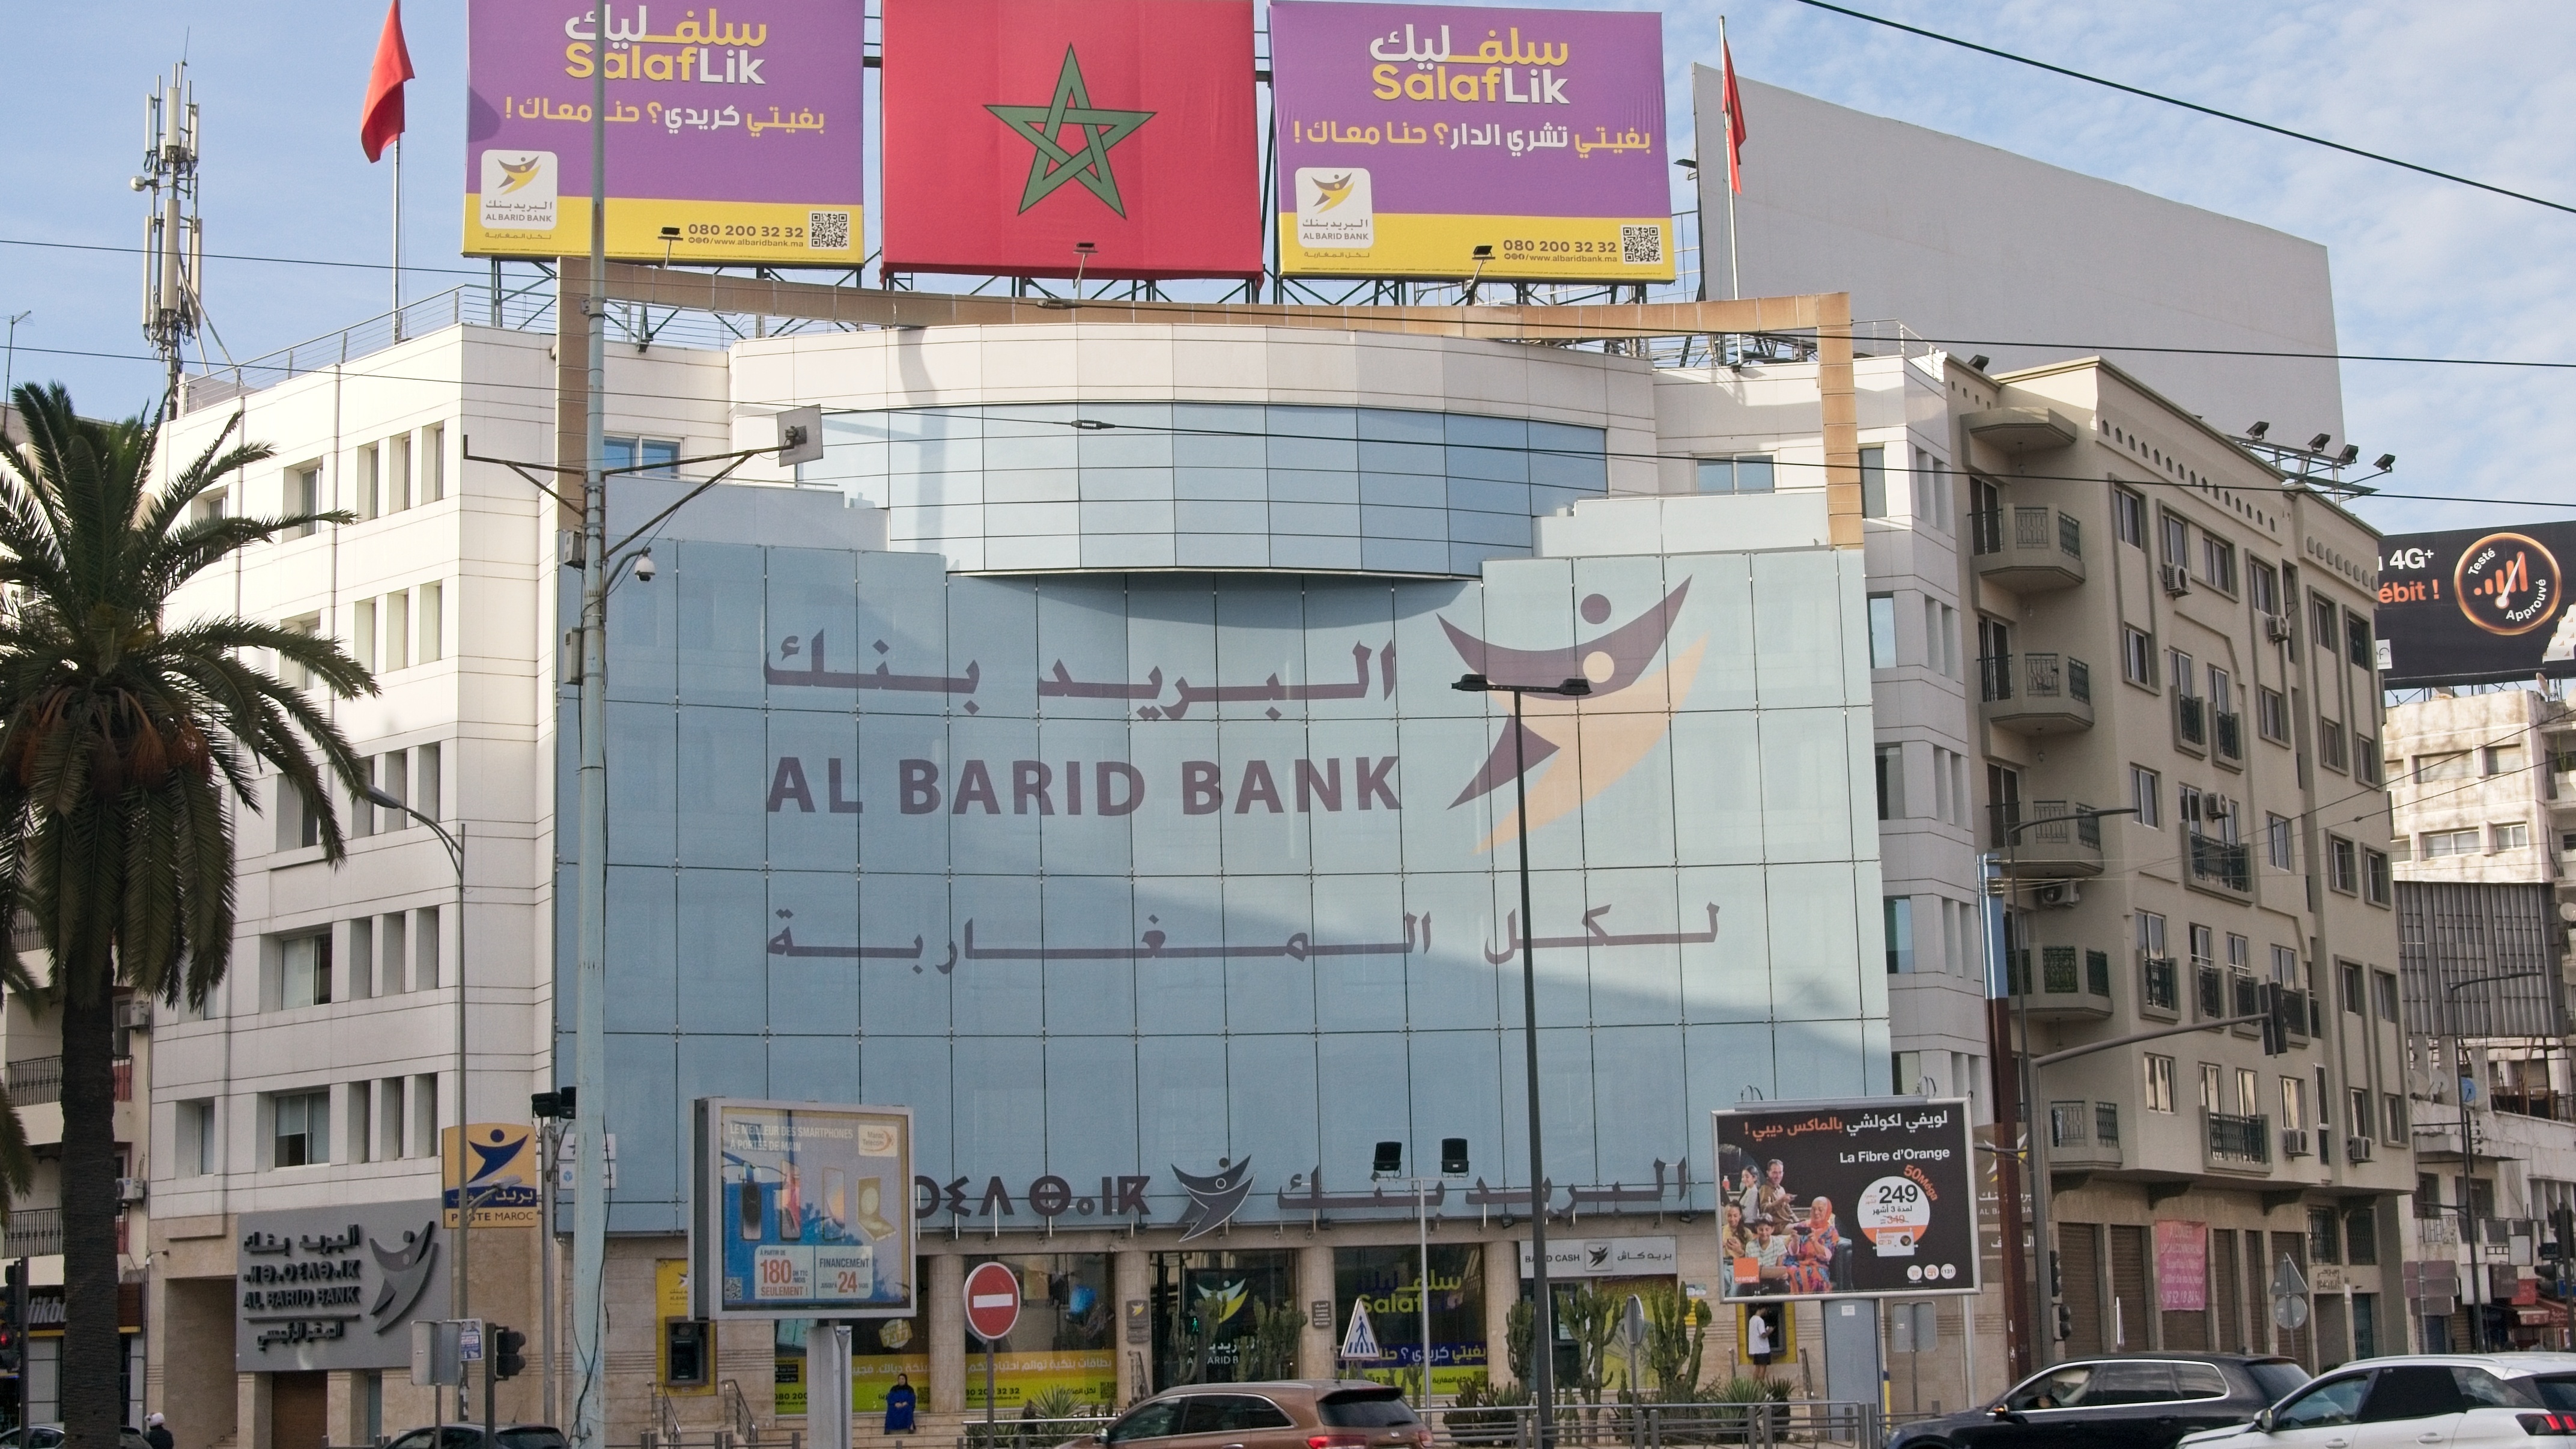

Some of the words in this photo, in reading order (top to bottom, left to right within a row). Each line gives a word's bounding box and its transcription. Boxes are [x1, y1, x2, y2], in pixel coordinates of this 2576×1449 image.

[1370, 23, 1569, 70] سلفليك
[565, 42, 766, 84] SalafLik
[1372, 64, 1570, 104] SalafLik
[519, 97, 592, 121] معاك
[604, 100, 639, 122] حن
[747, 107, 824, 137] بغيتي
[1294, 121, 1300, 144] !
[1307, 120, 1380, 145] معاك
[1387, 121, 1427, 144] حنا
[1507, 122, 1568, 156] تشري
[1574, 127, 1651, 159] بغيتي
[485, 199, 512, 211] بنك
[514, 201, 552, 211] البريد
[688, 223, 720, 235] 080
[725, 225, 756, 236] 200
[761, 226, 780, 237] 32
[785, 227, 803, 238] 32
[1302, 218, 1328, 230] بنك
[1330, 219, 1368, 230] البريد
[1503, 240, 1534, 251] 080
[1539, 241, 1570, 252] 200
[1575, 242, 1593, 252] 32
[1597, 242, 1617, 253] 32
[2389, 547, 2434, 570] 4G+
[2468, 547, 2496, 576] Testé
[2378, 581, 2426, 604] ébit
[2506, 579, 2547, 621] Approuvé
[762, 628, 980, 715] بنك
[1038, 640, 1397, 721] البريد
[766, 756, 863, 815] AL
[899, 758, 1146, 816] BARID
[1183, 756, 1402, 815] BANK
[767, 909, 1430, 975] المغاربة
[1484, 902, 1720, 965] لكل
[730, 1124, 740, 1134] LE
[798, 1126, 853, 1138] SMARTPHONES
[1787, 1116, 1842, 1136] بالماكس
[1847, 1113, 1901, 1136] لكولشي
[1906, 1110, 1948, 1133] لويفي
[1752, 1126, 1783, 1141] ديبي
[769, 1141, 779, 1151] DE
[1839, 1152, 1855, 1164] La
[1858, 1150, 1889, 1163] Fibre
[496, 1189, 533, 1204] بريد
[1879, 1184, 1918, 1204] 249
[452, 1212, 491, 1221] PSTE
[495, 1211, 533, 1221] MAROC
[1873, 1204, 1888, 1215] أشهر
[819, 1258, 869, 1268] FINANCEMENT
[1555, 1254, 1580, 1262] CASH
[1617, 1250, 1645, 1262] كاش
[760, 1259, 792, 1284] 180
[838, 1271, 857, 1293] 24
[243, 1292, 264, 1310] AL
[266, 1289, 315, 1308] BARID
[316, 1286, 360, 1306] BANK
[761, 1286, 803, 1296] SEULEMENT
[1207, 1356, 1231, 1364] ARID
